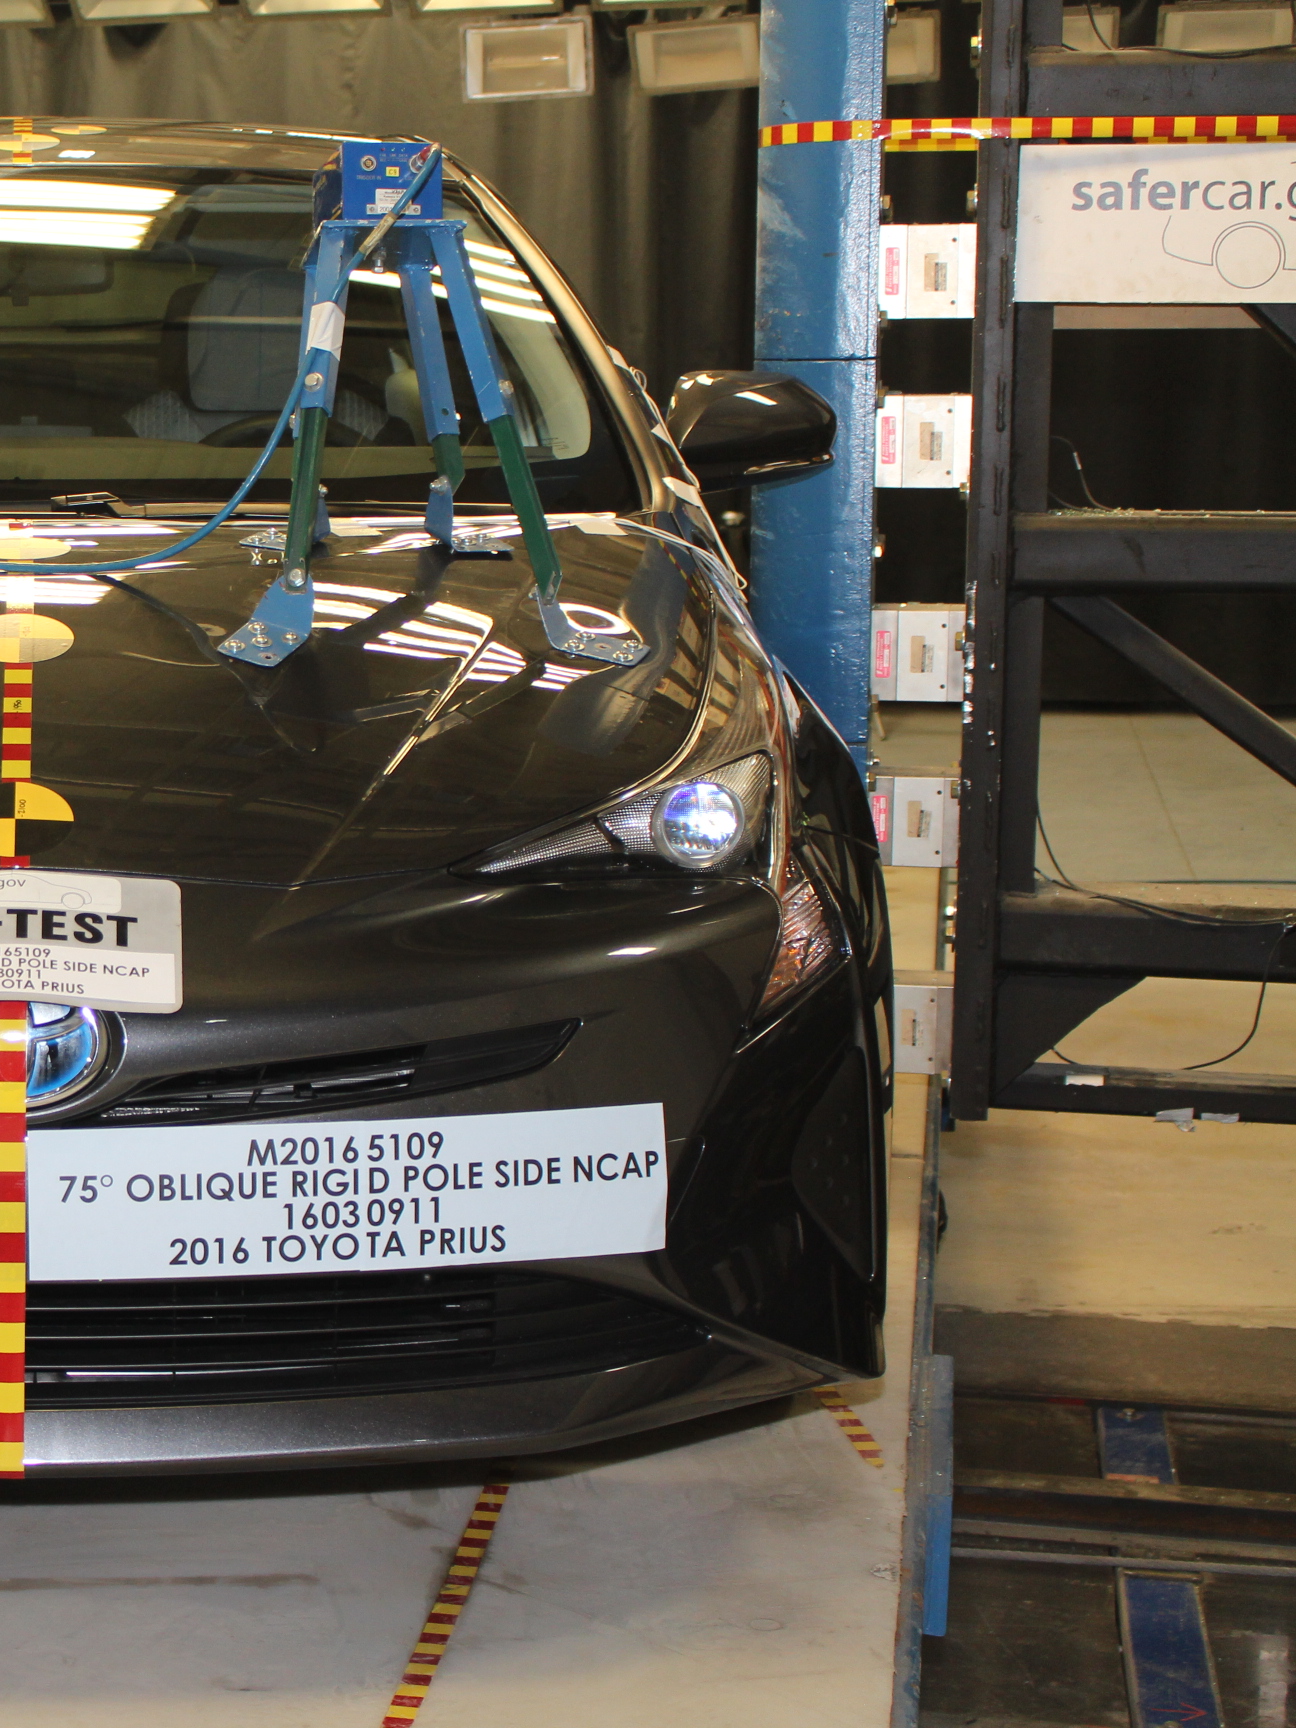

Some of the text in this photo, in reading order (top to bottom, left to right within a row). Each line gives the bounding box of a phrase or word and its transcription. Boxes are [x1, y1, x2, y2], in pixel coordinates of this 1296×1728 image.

[18, 957, 59, 971] POLE
[64, 961, 98, 974] SIDE
[103, 964, 150, 978] NCAP
[41, 981, 84, 995] PRIUS
[247, 1131, 444, 1167] M20165109
[59, 1150, 660, 1204] 75° OBLIQUE RIGID POLE SIDE NCAP
[283, 1196, 442, 1230] 16030911
[169, 1224, 506, 1266] 2016 TOYOTA PRIUS
